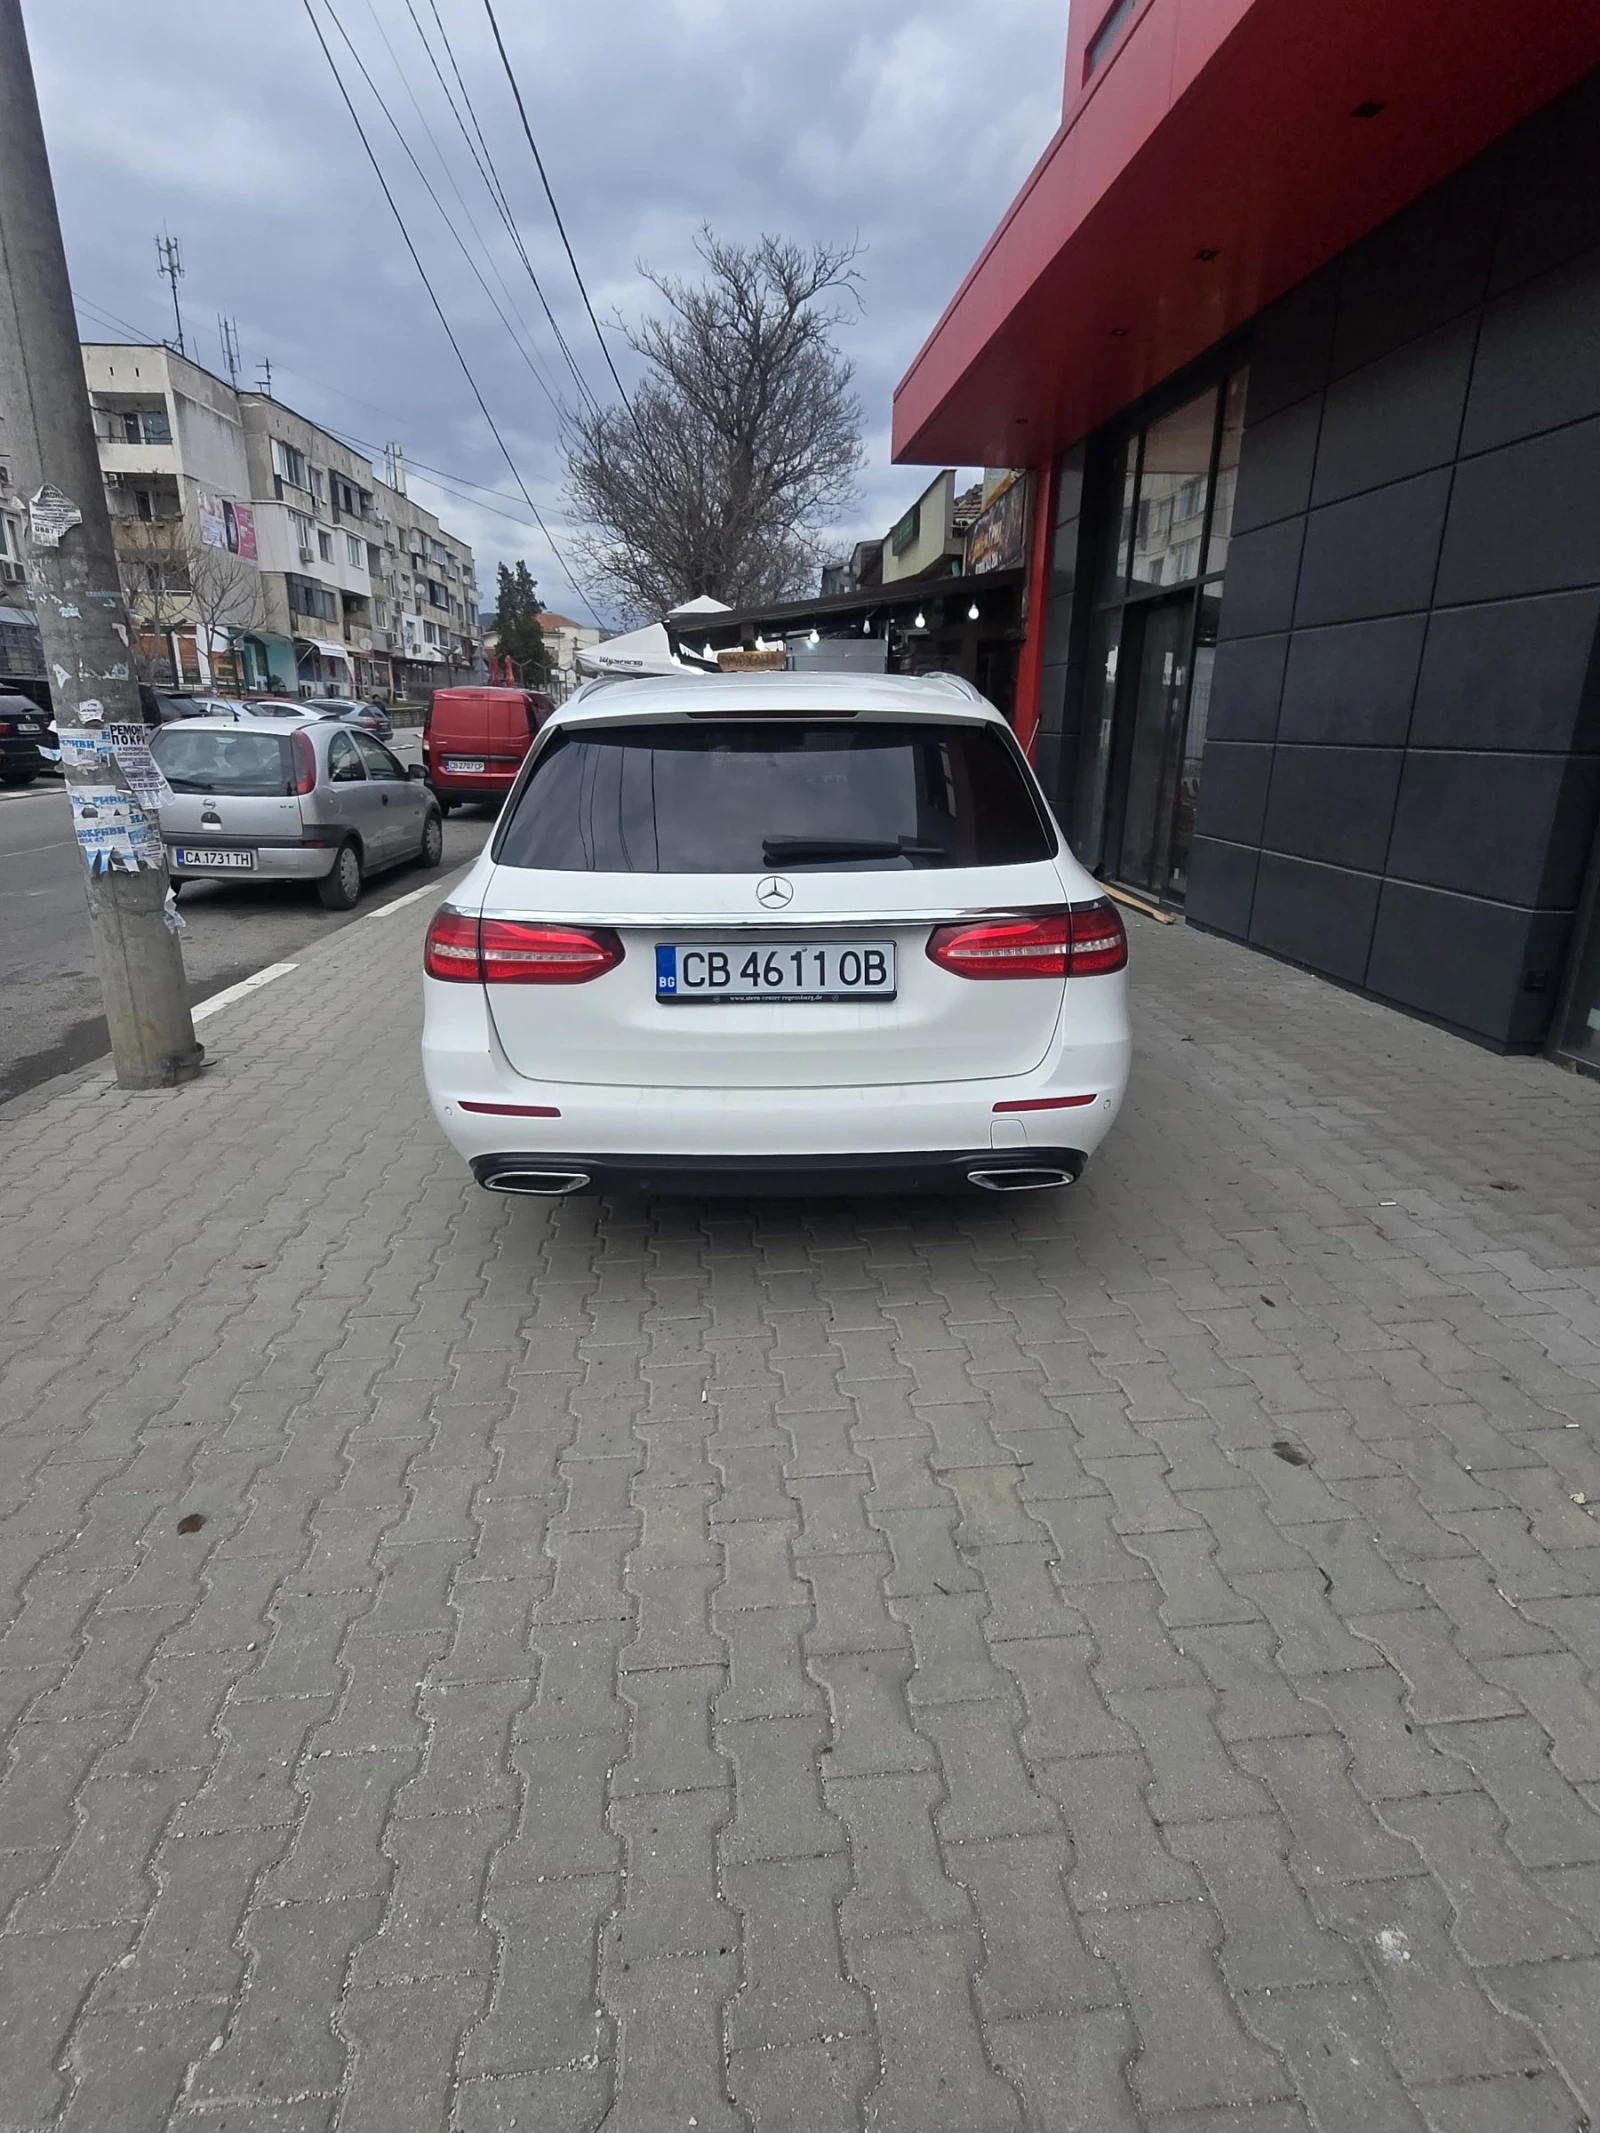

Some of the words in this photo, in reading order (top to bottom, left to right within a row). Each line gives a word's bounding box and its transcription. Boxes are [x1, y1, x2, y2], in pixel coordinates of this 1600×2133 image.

[185, 852, 201, 863] CA
[204, 853, 231, 865] 1731
[233, 854, 249, 865] TH
[659, 976, 675, 988] BG
[682, 951, 731, 987] CB
[739, 950, 826, 987] 4611
